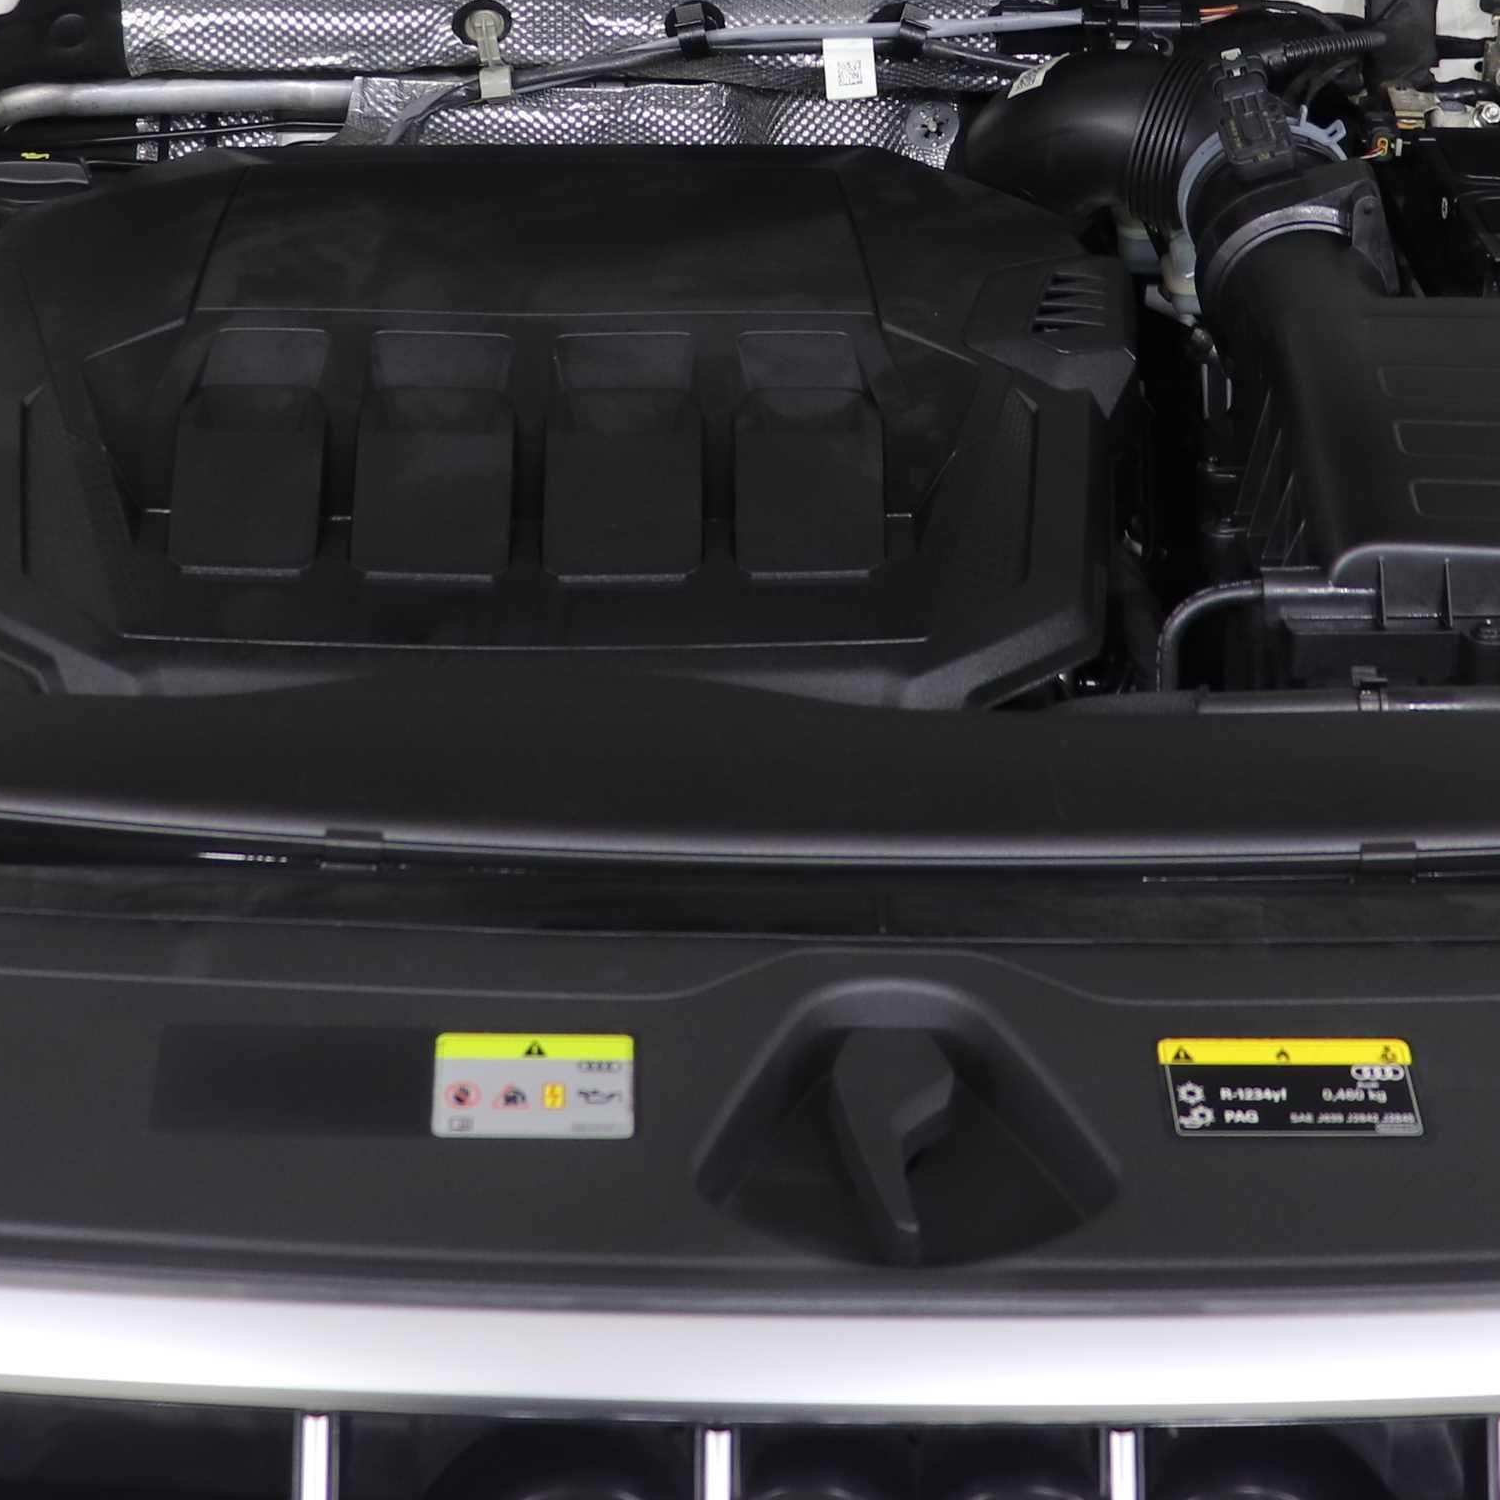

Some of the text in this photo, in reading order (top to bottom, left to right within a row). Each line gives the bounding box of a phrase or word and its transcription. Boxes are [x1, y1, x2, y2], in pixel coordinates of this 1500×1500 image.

[1220, 1086, 1288, 1103] R-1234yf
[1367, 1089, 1388, 1104] kg
[1224, 1109, 1260, 1124] PAG
